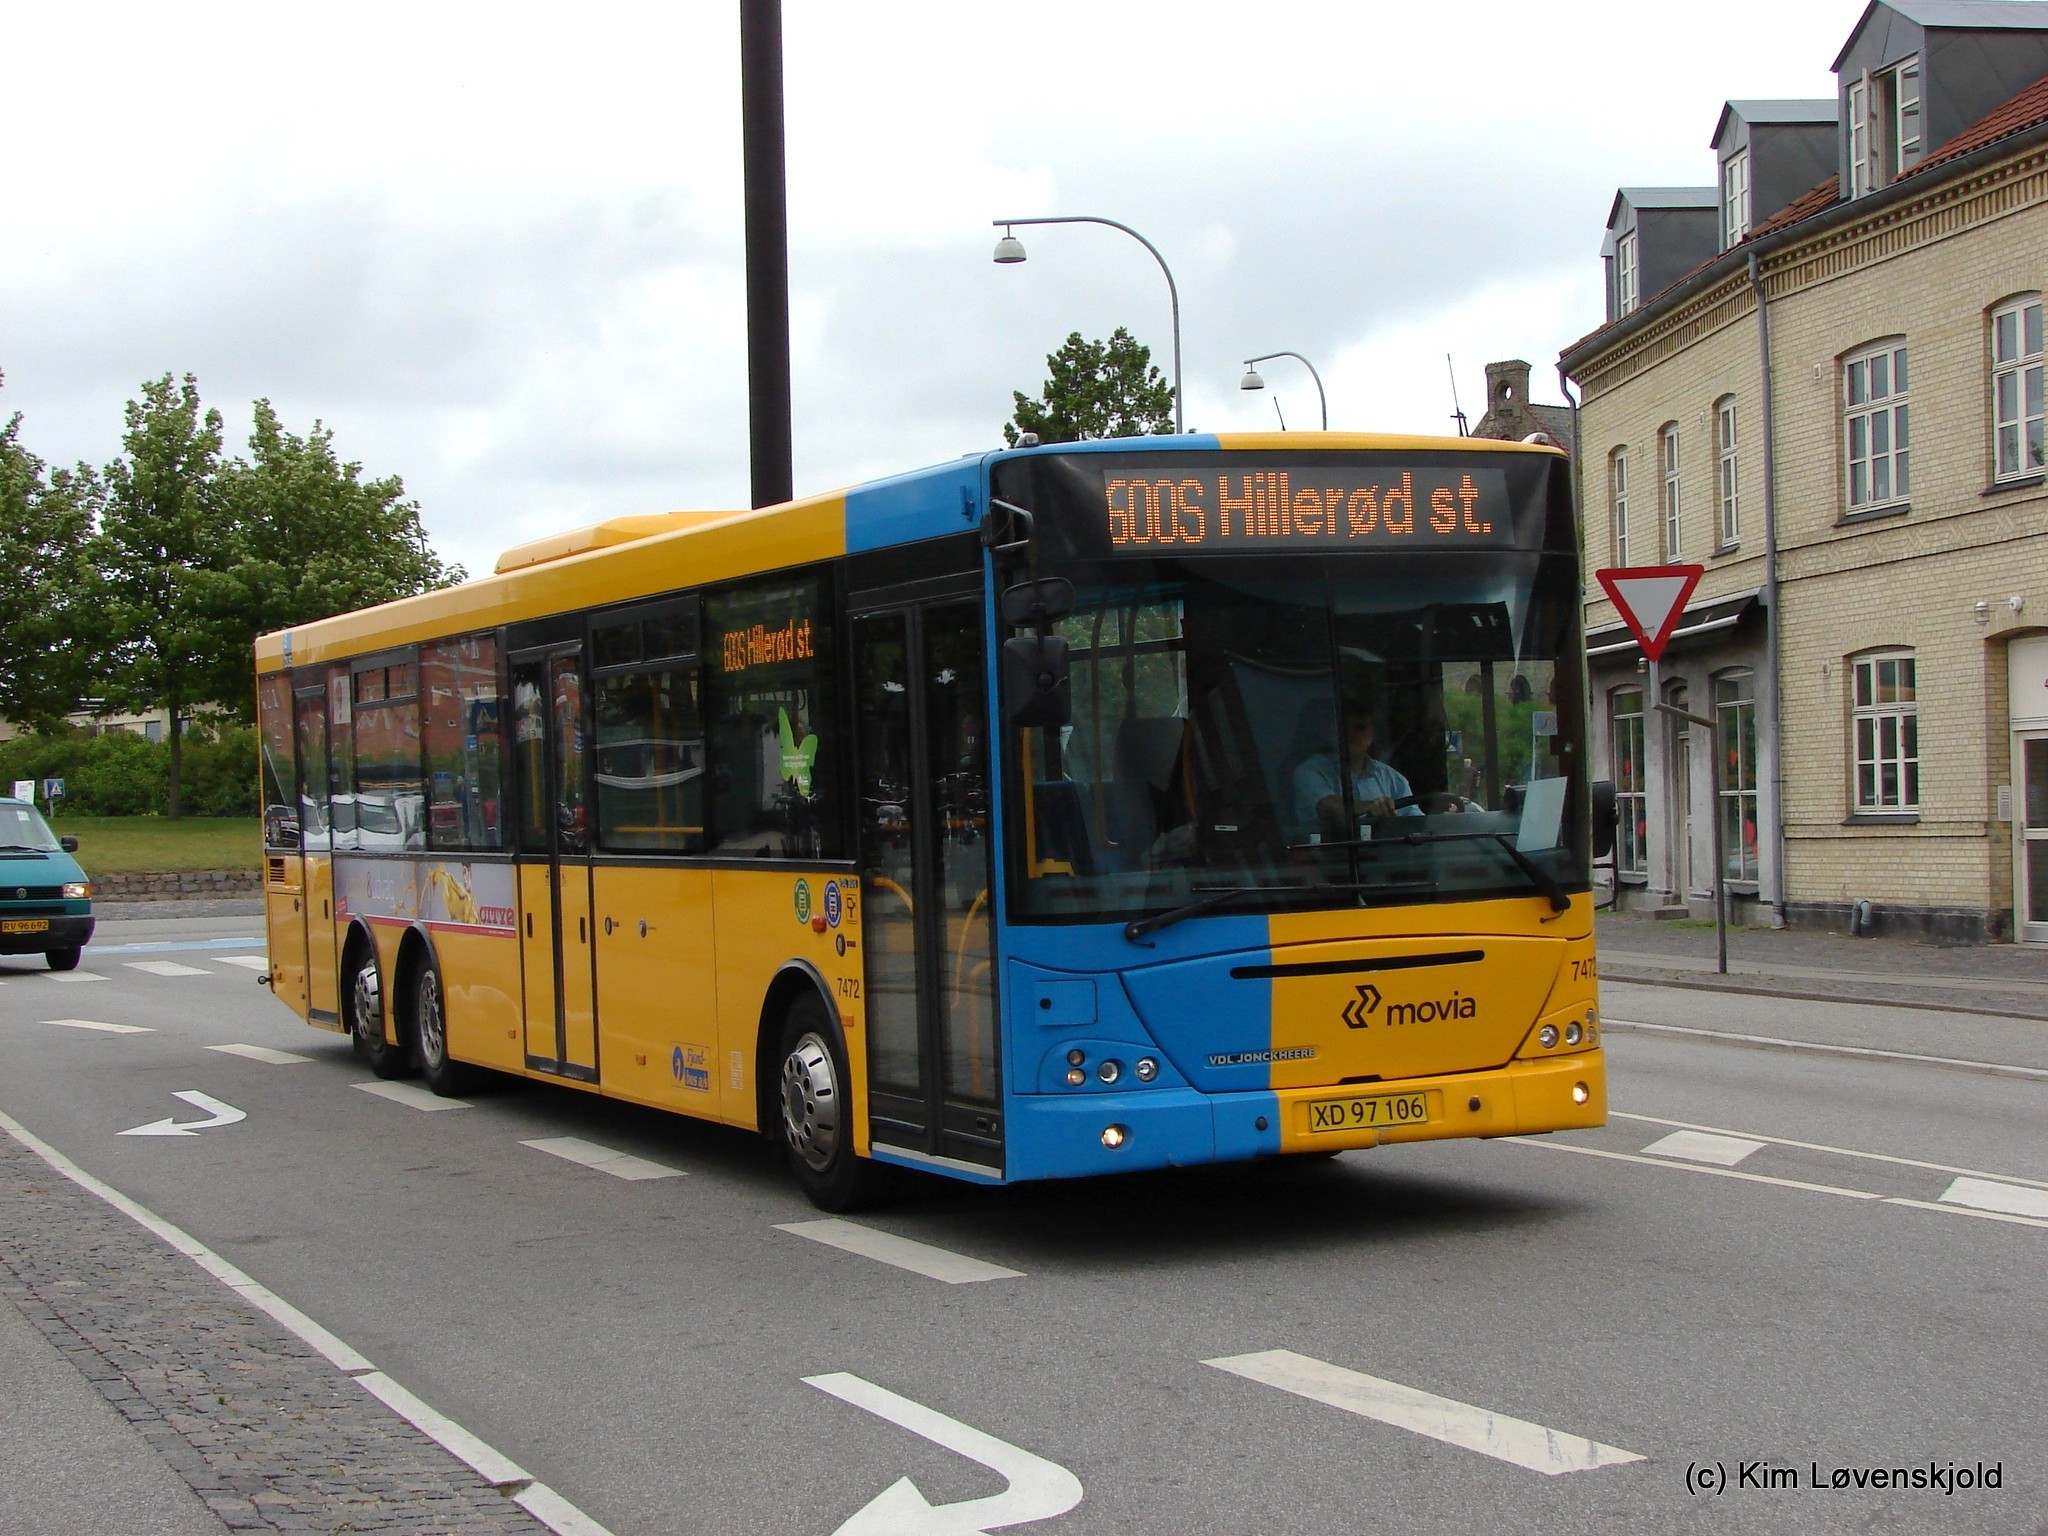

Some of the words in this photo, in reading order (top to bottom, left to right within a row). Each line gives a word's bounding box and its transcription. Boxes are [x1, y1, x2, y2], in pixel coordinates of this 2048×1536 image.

[1105, 479, 1206, 544] 600S
[1218, 472, 1414, 538] Hillerød
[1429, 474, 1492, 534] st.
[747, 619, 794, 665] Hillerød
[797, 619, 814, 659] st.
[4, 922, 16, 931] RV
[18, 922, 29, 930] 96
[31, 921, 47, 930] 692
[837, 978, 860, 999] 7472
[1386, 990, 1477, 1027] movia
[1209, 1055, 1234, 1065] VDL
[1236, 1048, 1315, 1063] JONCKHEERE
[1315, 1104, 1345, 1127] XD
[1351, 1101, 1377, 1123] 97
[1385, 1097, 1423, 1120] 106
